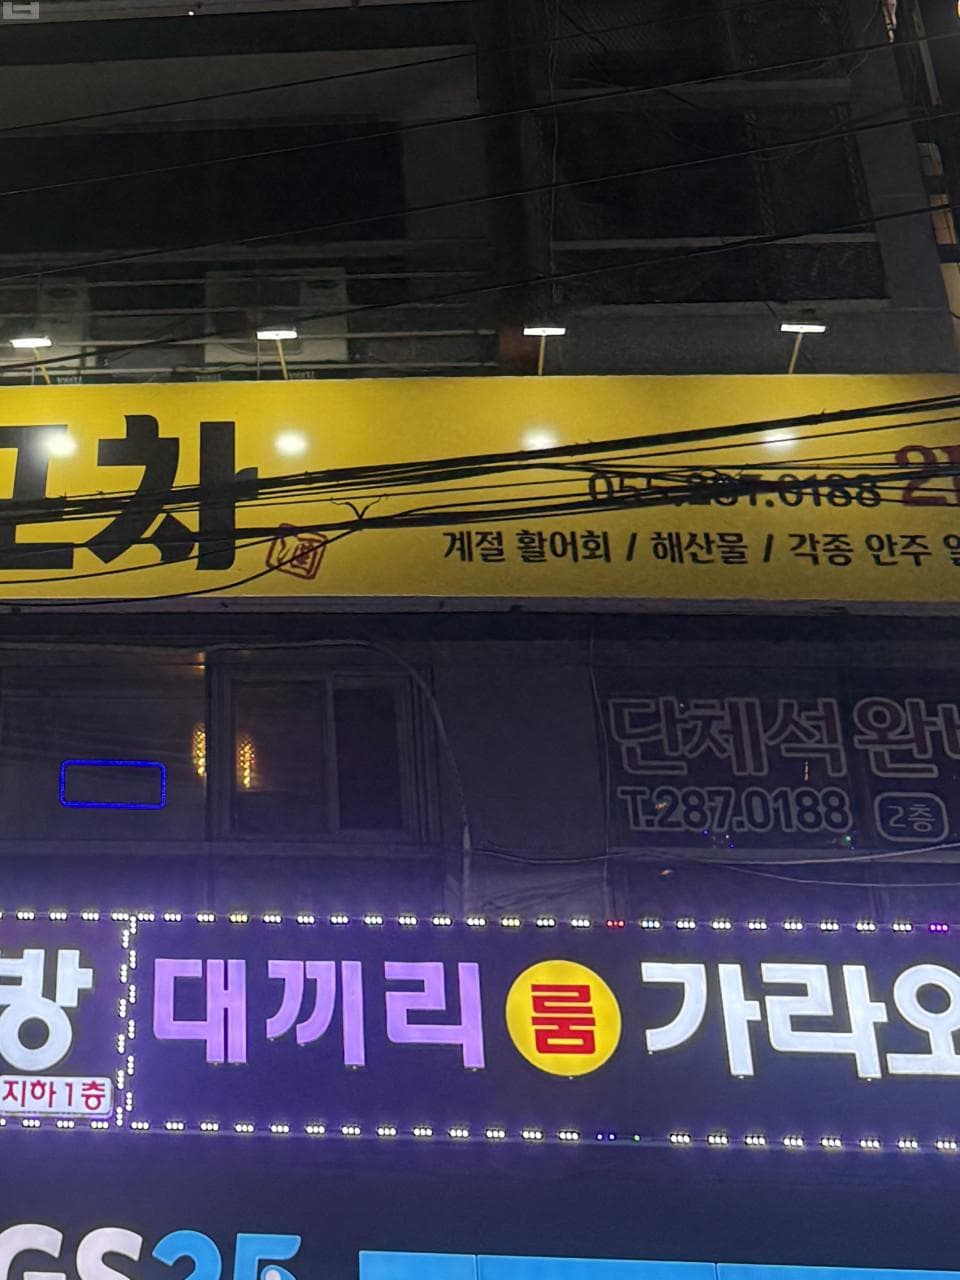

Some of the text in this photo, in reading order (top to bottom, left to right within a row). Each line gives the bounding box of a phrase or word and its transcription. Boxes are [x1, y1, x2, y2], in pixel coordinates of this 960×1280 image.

[442, 530, 506, 563] 계절
[515, 529, 612, 563] 활어회
[626, 532, 638, 562] /
[650, 530, 749, 565] 해산물
[762, 532, 774, 563] /
[788, 531, 855, 567] 각종
[864, 532, 933, 567] 안주
[607, 696, 849, 777] 단체석
[616, 785, 855, 833] T.287.0188
[886, 802, 937, 833] 2층
[153, 958, 486, 1070] 대끼리
[531, 984, 596, 1055] 룸
